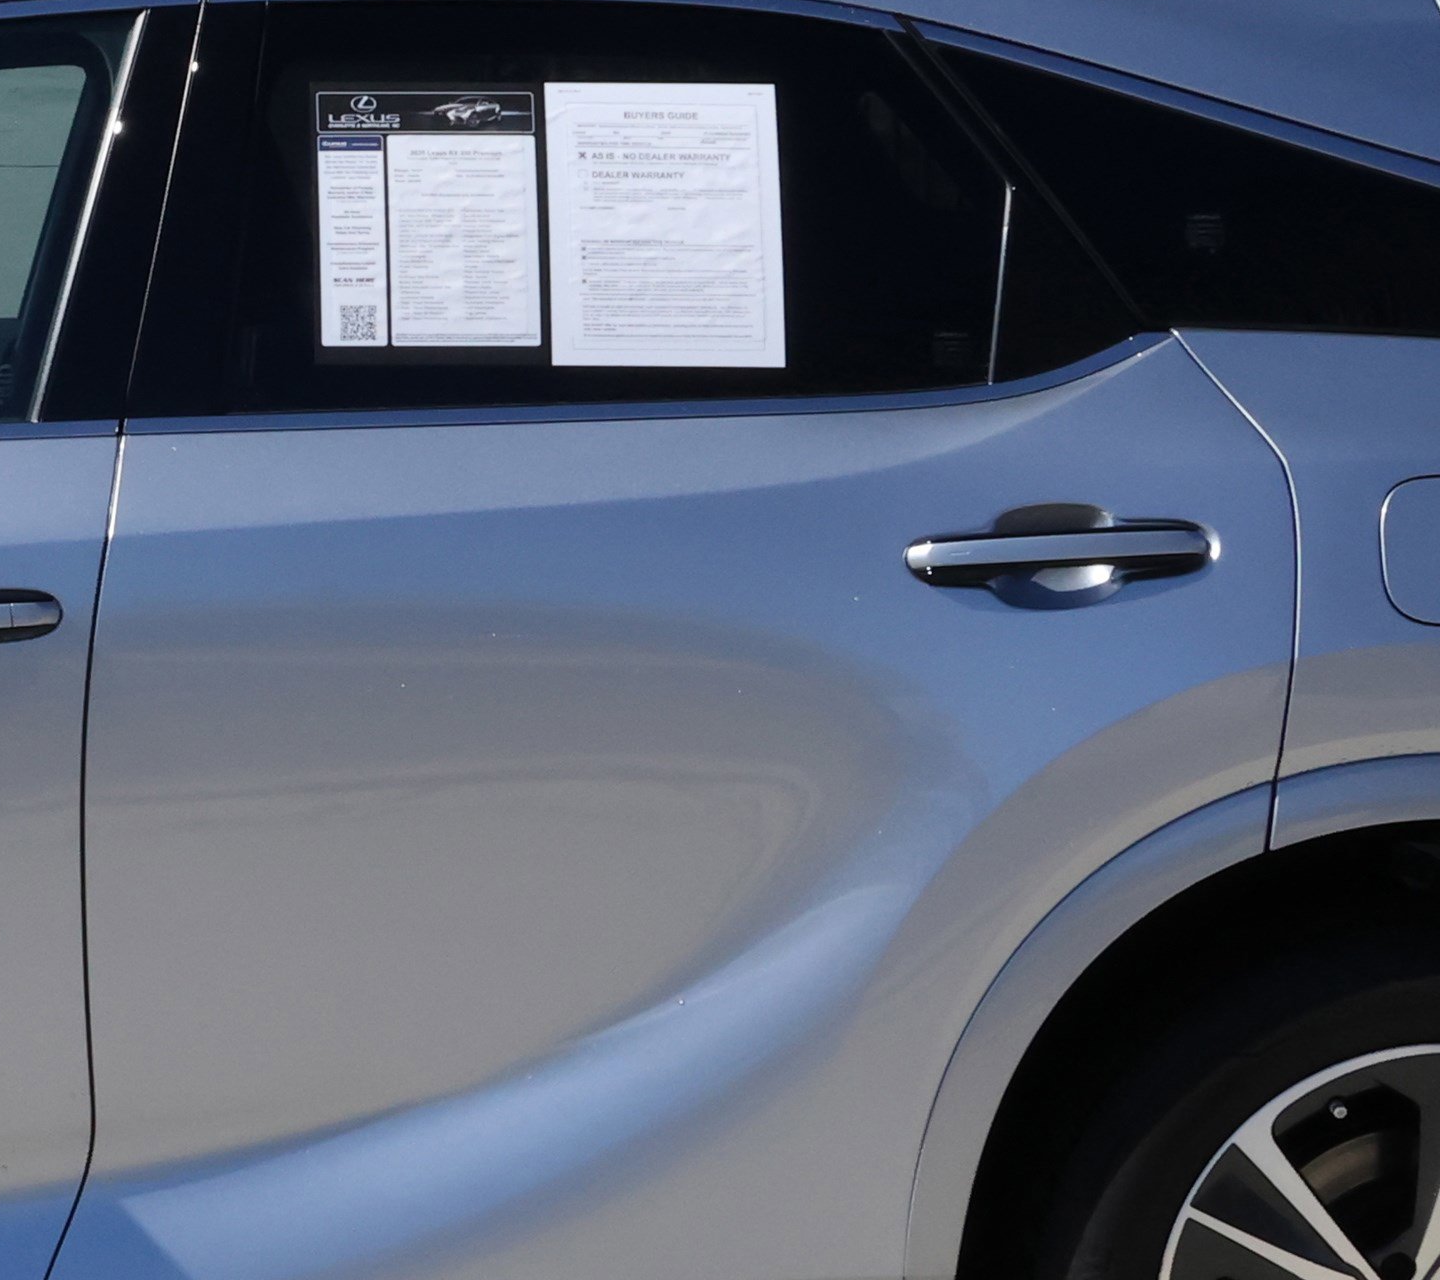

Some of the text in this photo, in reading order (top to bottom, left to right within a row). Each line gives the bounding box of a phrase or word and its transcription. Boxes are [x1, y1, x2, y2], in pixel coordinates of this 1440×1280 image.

[328, 113, 401, 123] LEXUS
[623, 111, 699, 120] BUYERS GUIDE
[591, 152, 604, 160] AS
[605, 152, 615, 160] IS
[622, 152, 636, 160] NO
[638, 152, 676, 161] DEALER
[679, 153, 731, 161] WARRANTY
[631, 171, 685, 179] WARRANTY
